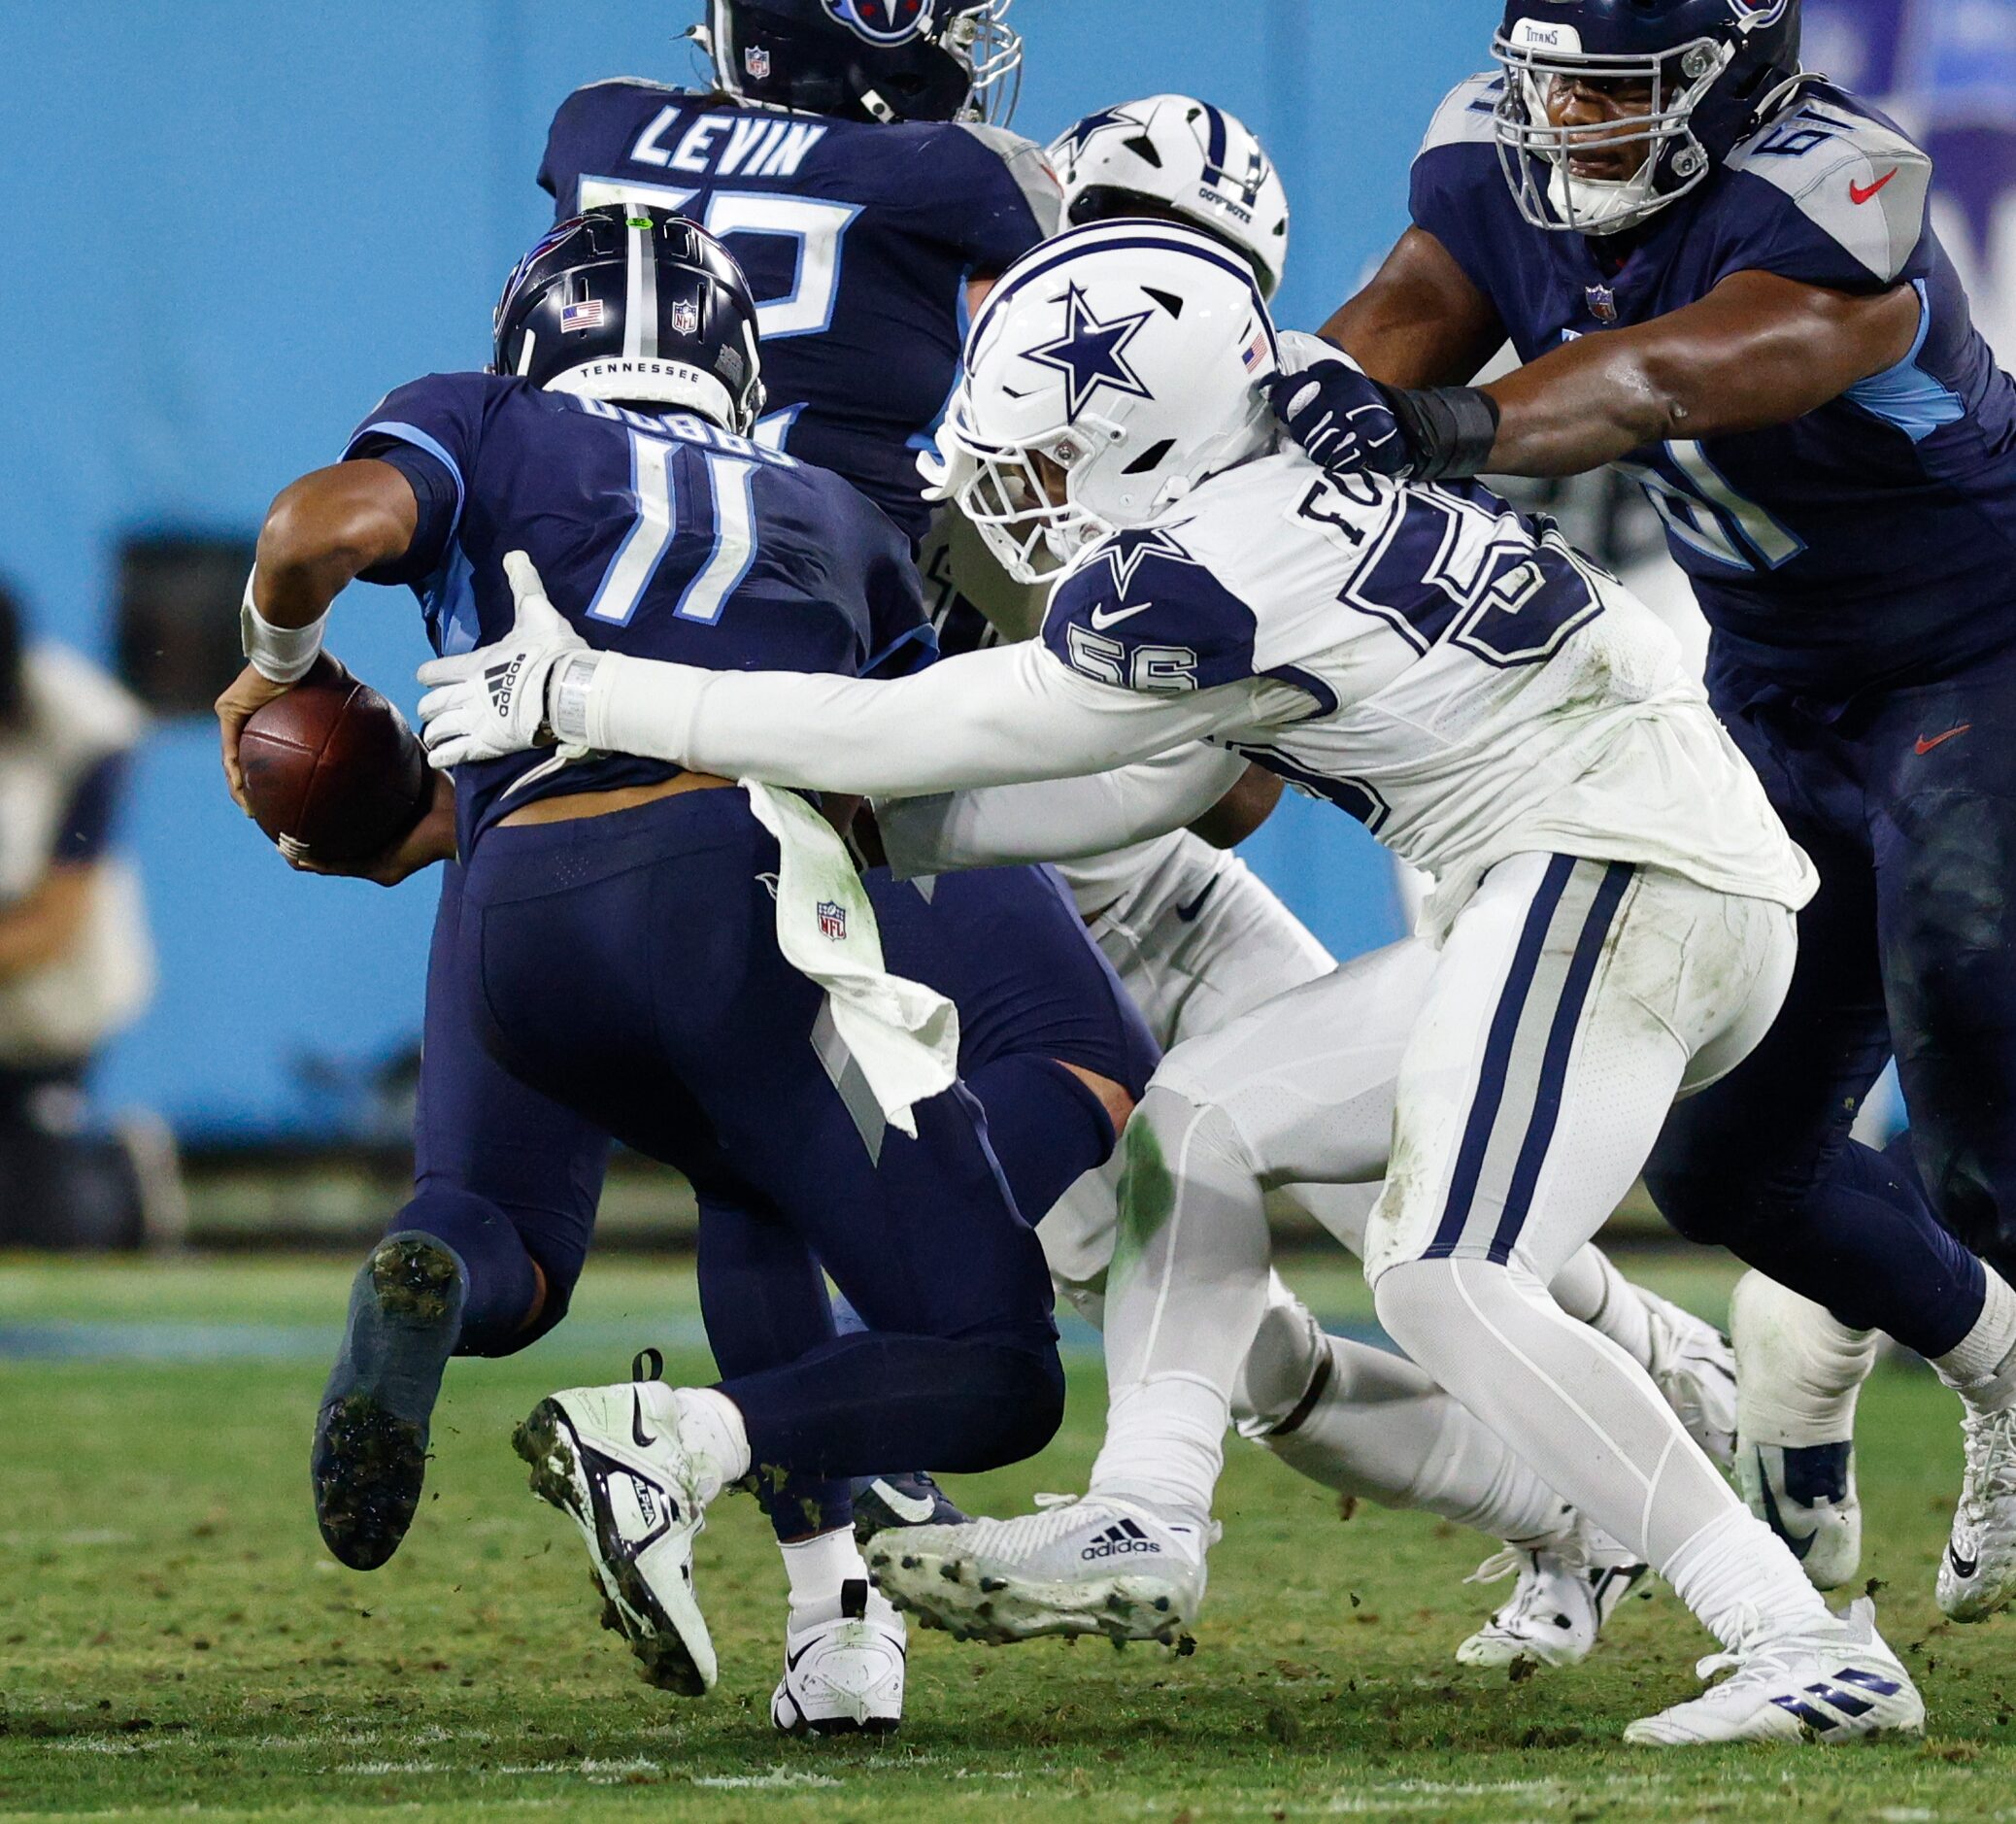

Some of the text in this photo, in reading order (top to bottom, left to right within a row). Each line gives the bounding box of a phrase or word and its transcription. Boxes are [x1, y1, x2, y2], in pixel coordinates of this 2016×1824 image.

[1526, 25, 1559, 46] TITANS
[630, 104, 828, 177] LEVIN
[580, 362, 699, 383] TENNESSEE
[585, 426, 761, 626] 11
[1066, 622, 1198, 692] 56
[498, 653, 526, 718] adidas
[820, 915, 845, 938] NFL
[631, 1474, 656, 1529] ALPHA
[1081, 1538, 1161, 1562] adidas
